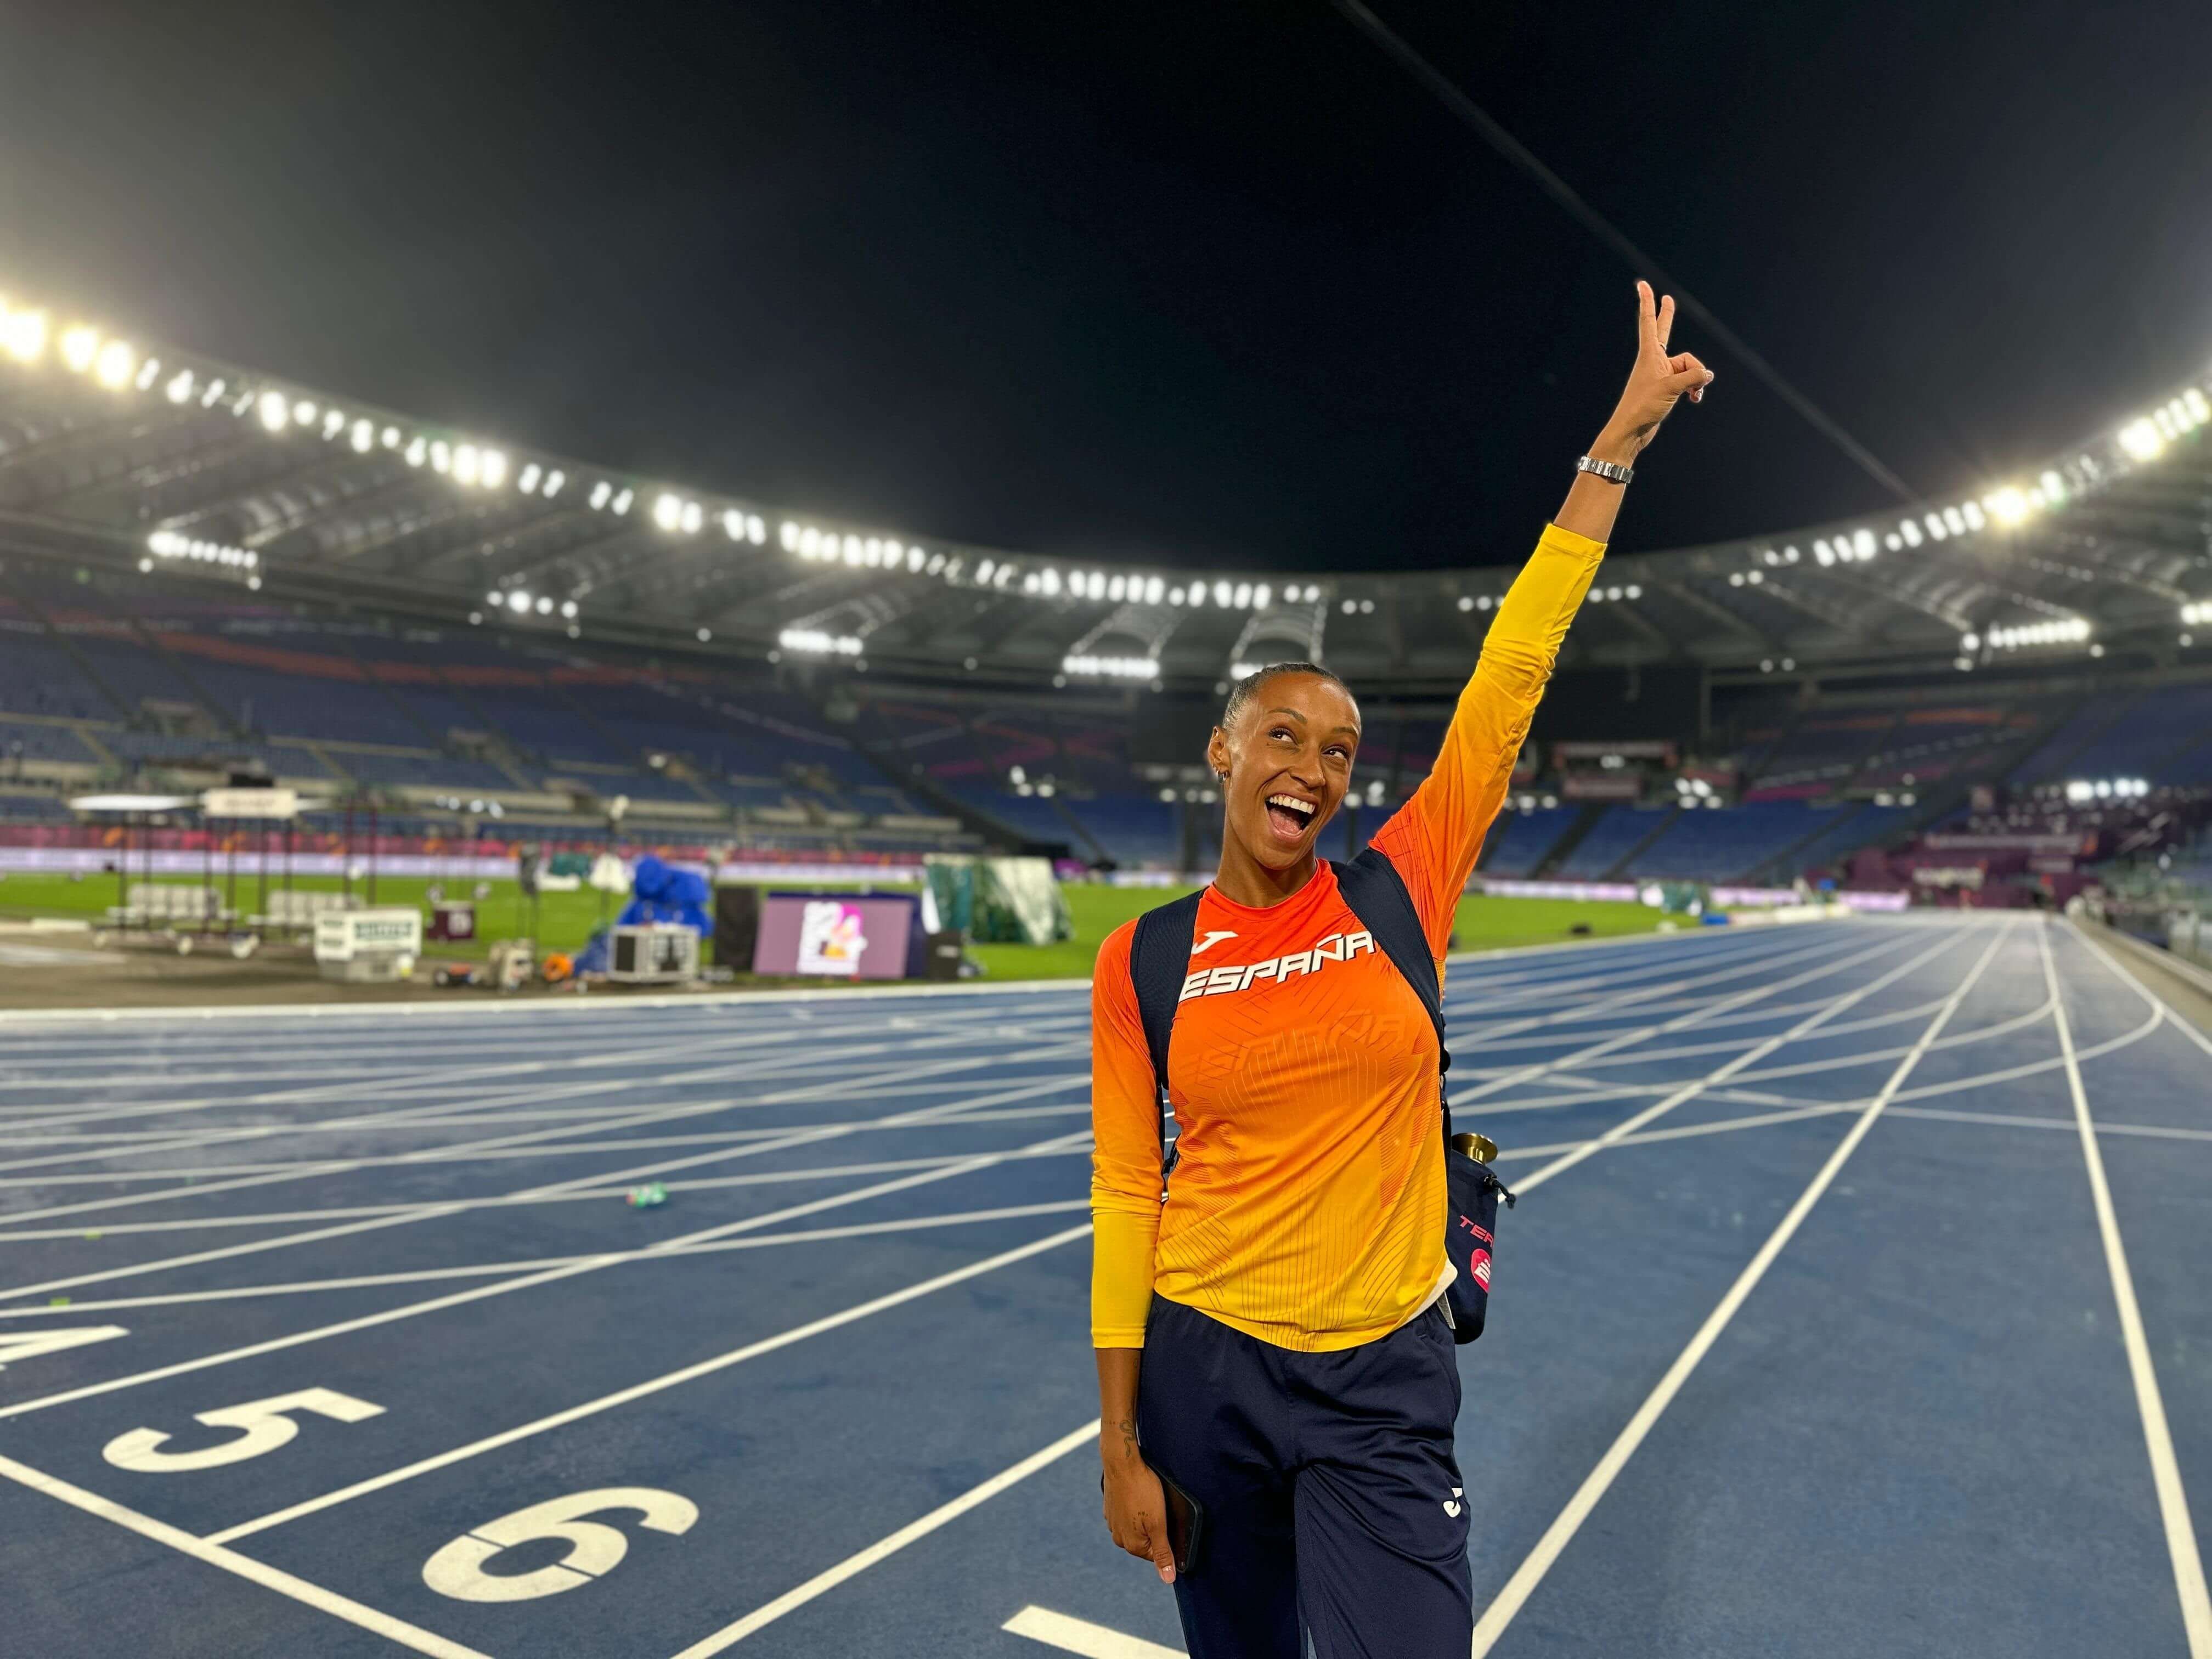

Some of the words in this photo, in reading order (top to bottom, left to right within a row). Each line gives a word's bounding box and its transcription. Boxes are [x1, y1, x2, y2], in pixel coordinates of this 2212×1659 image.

[1178, 930, 1375, 1003] ESPAÑA
[102, 1387, 387, 1472] 5
[422, 1487, 699, 1602] 6
